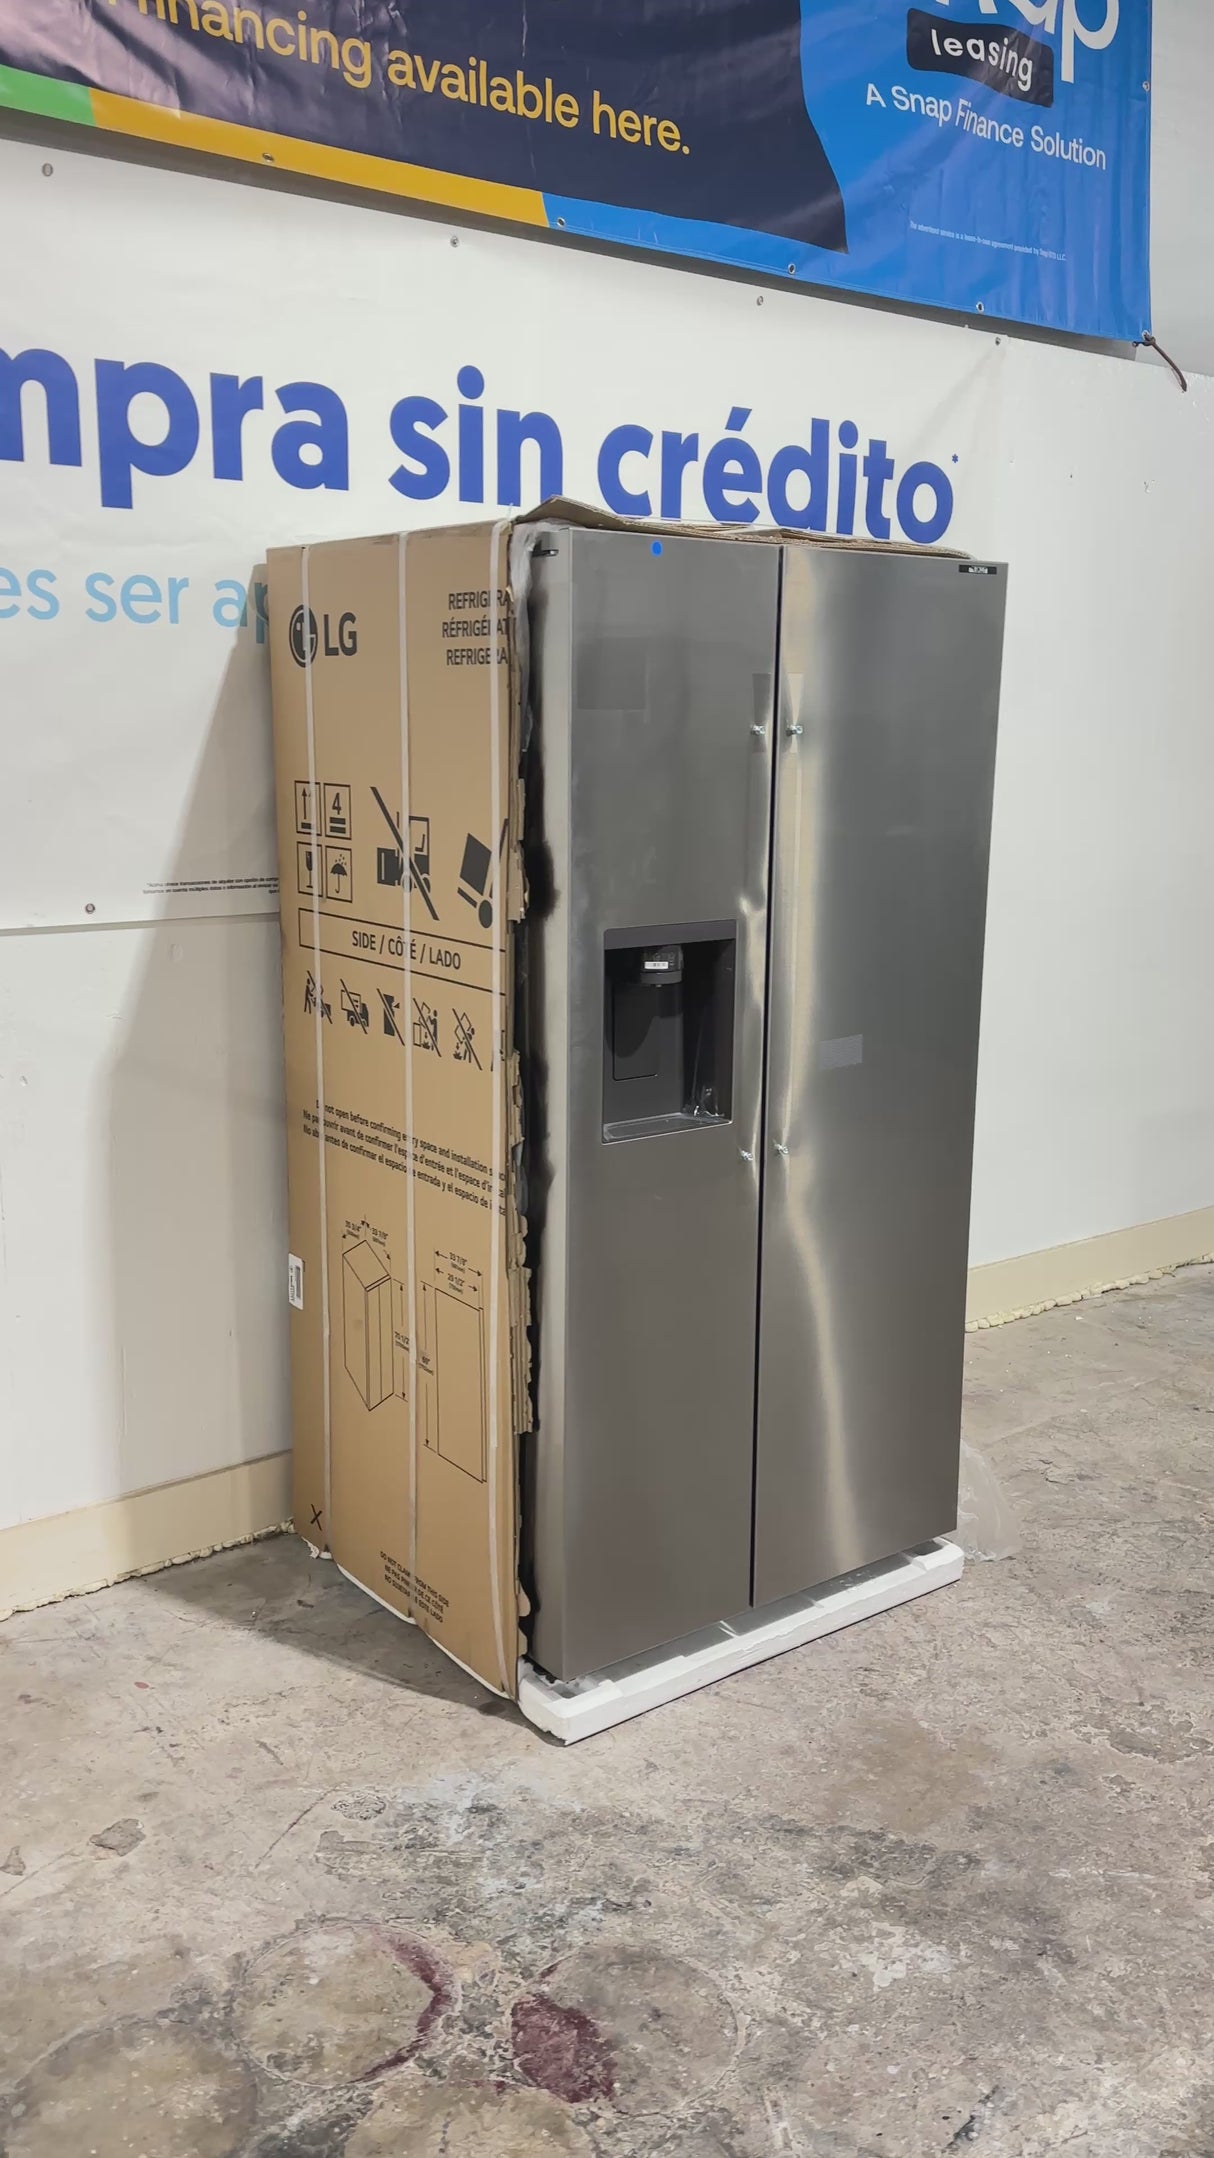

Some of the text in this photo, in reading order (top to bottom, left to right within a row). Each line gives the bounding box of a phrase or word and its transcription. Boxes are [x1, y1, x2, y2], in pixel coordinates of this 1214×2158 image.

[931, 28, 1034, 92] leasing
[387, 46, 579, 129] available
[593, 90, 690, 155] here.
[866, 83, 1107, 170] A Snap Finance Solution
[388, 365, 563, 508] sin
[85, 571, 189, 625] ser
[323, 612, 358, 656] LG
[332, 792, 342, 815] 4
[352, 930, 462, 970] SIDE / CÔÉ / LADO
